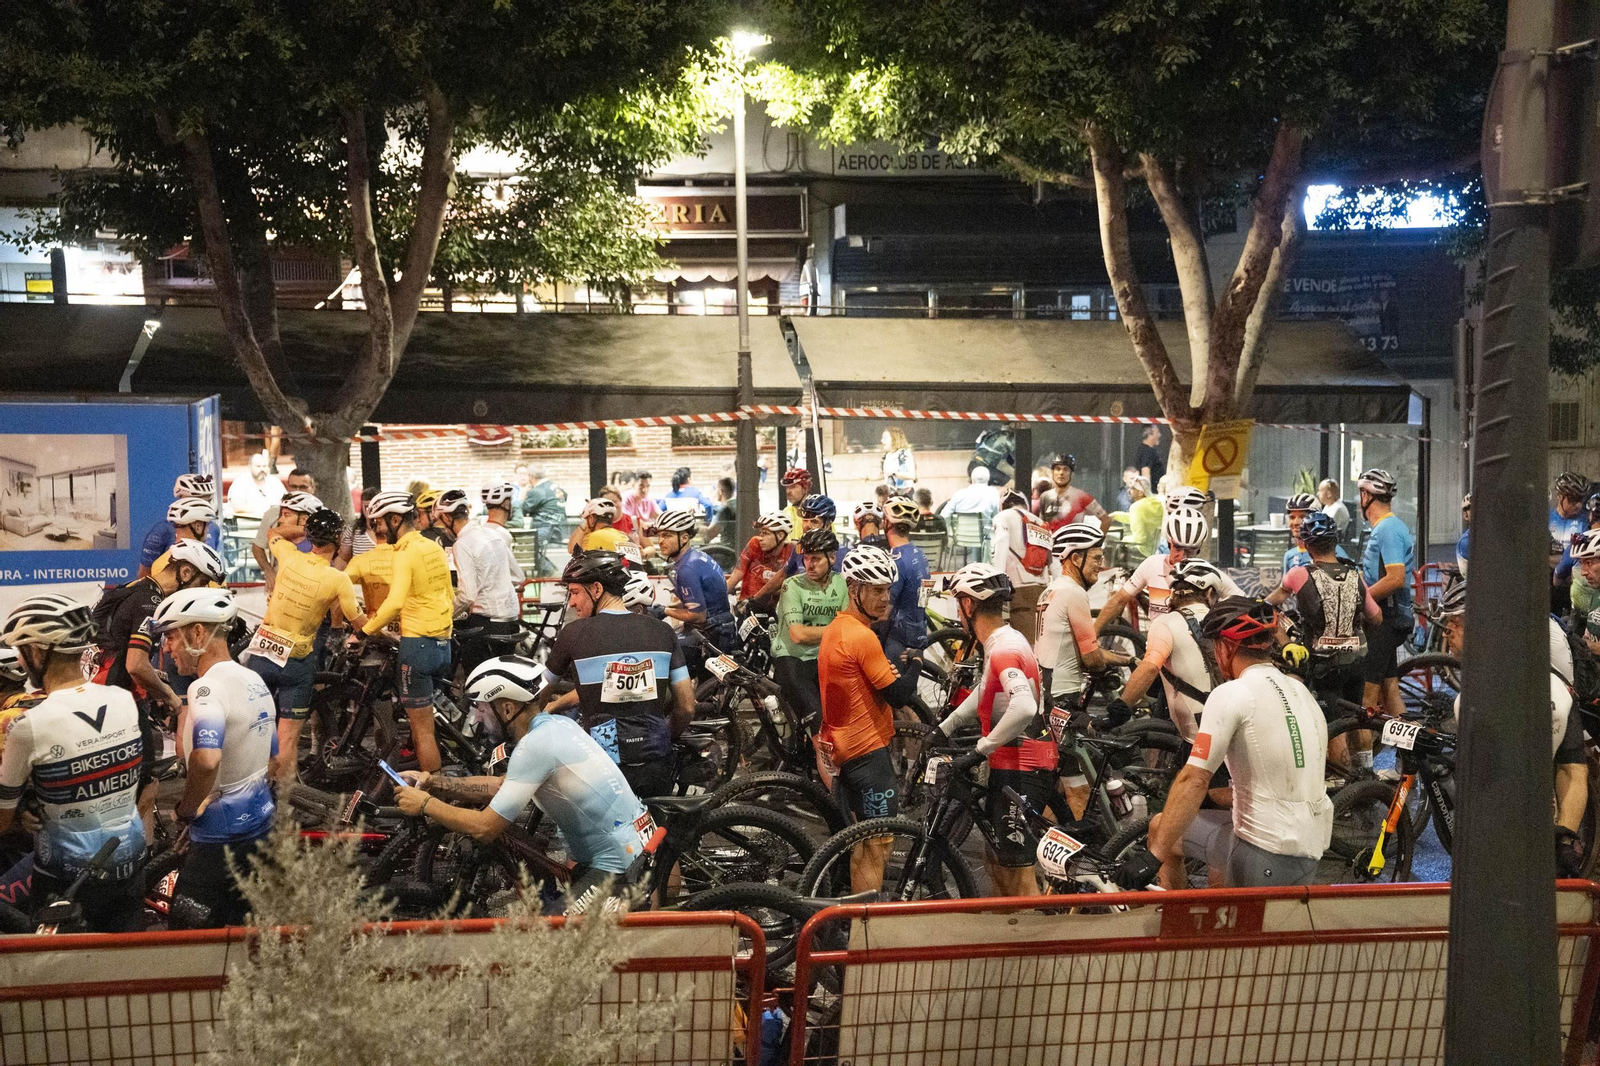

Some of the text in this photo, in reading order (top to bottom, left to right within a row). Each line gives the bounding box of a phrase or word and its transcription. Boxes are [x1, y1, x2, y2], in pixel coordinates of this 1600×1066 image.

[921, 154, 941, 170] DE
[1294, 278, 1338, 293] VENDE
[1381, 335, 1399, 350] 73
[33, 568, 129, 580] INTERIORISMO
[803, 603, 841, 617] PROLONG
[387, 621, 400, 633] 68
[259, 638, 285, 656] 6709
[616, 672, 648, 690] 5071
[486, 687, 503, 700] ABUS
[75, 729, 126, 748] VERAIMPORT
[1389, 722, 1418, 739] 6974
[1288, 716, 1304, 767] Roquetas
[70, 743, 138, 775] BIKESTORE
[75, 767, 138, 800] ALMERÍA
[1431, 781, 1455, 836] cannonda
[1042, 841, 1072, 866] 6927
